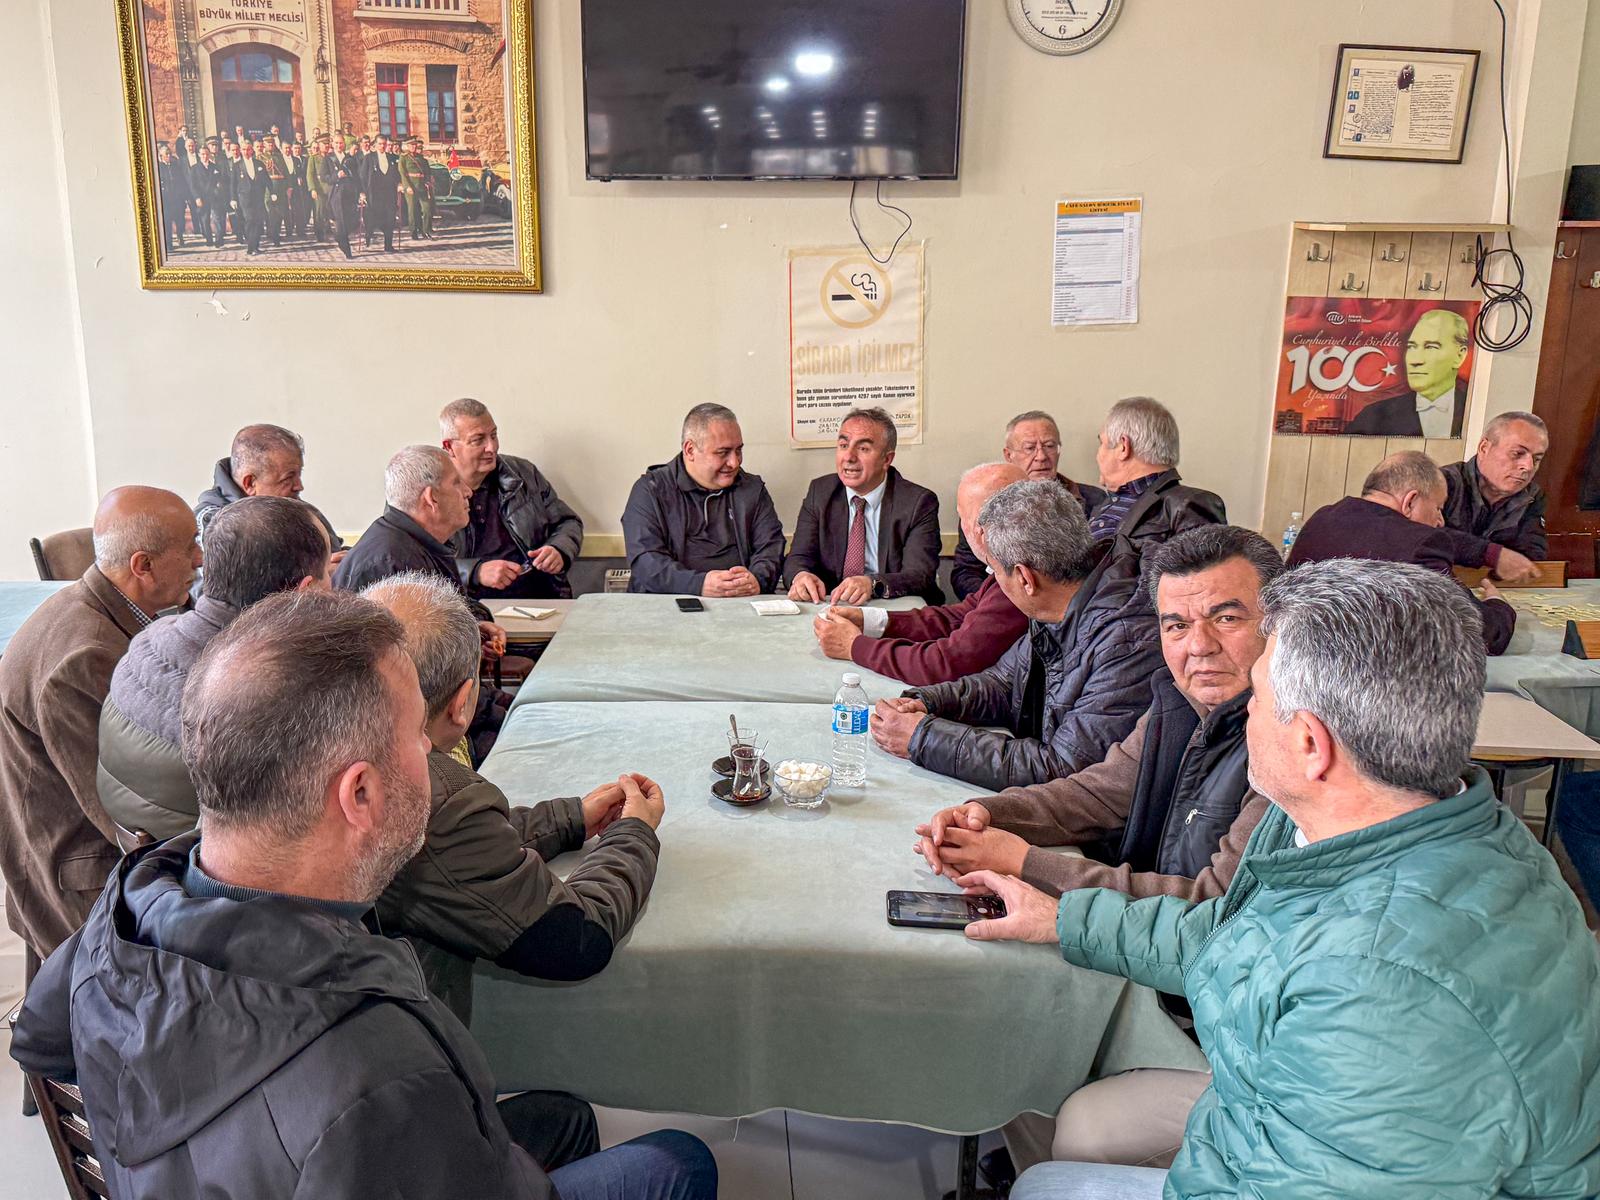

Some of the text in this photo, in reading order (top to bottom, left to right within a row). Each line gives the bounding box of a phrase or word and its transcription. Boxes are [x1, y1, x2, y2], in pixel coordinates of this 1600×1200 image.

[199, 8, 304, 23] BÜYÜK MİLLET MECLİSİ
[1058, 24, 1067, 35] 6
[1292, 330, 1402, 348] Cumhuriyet ile Birlikte
[796, 338, 915, 378] SİGARA İÇİLMEZ
[1286, 345, 1386, 394] 100
